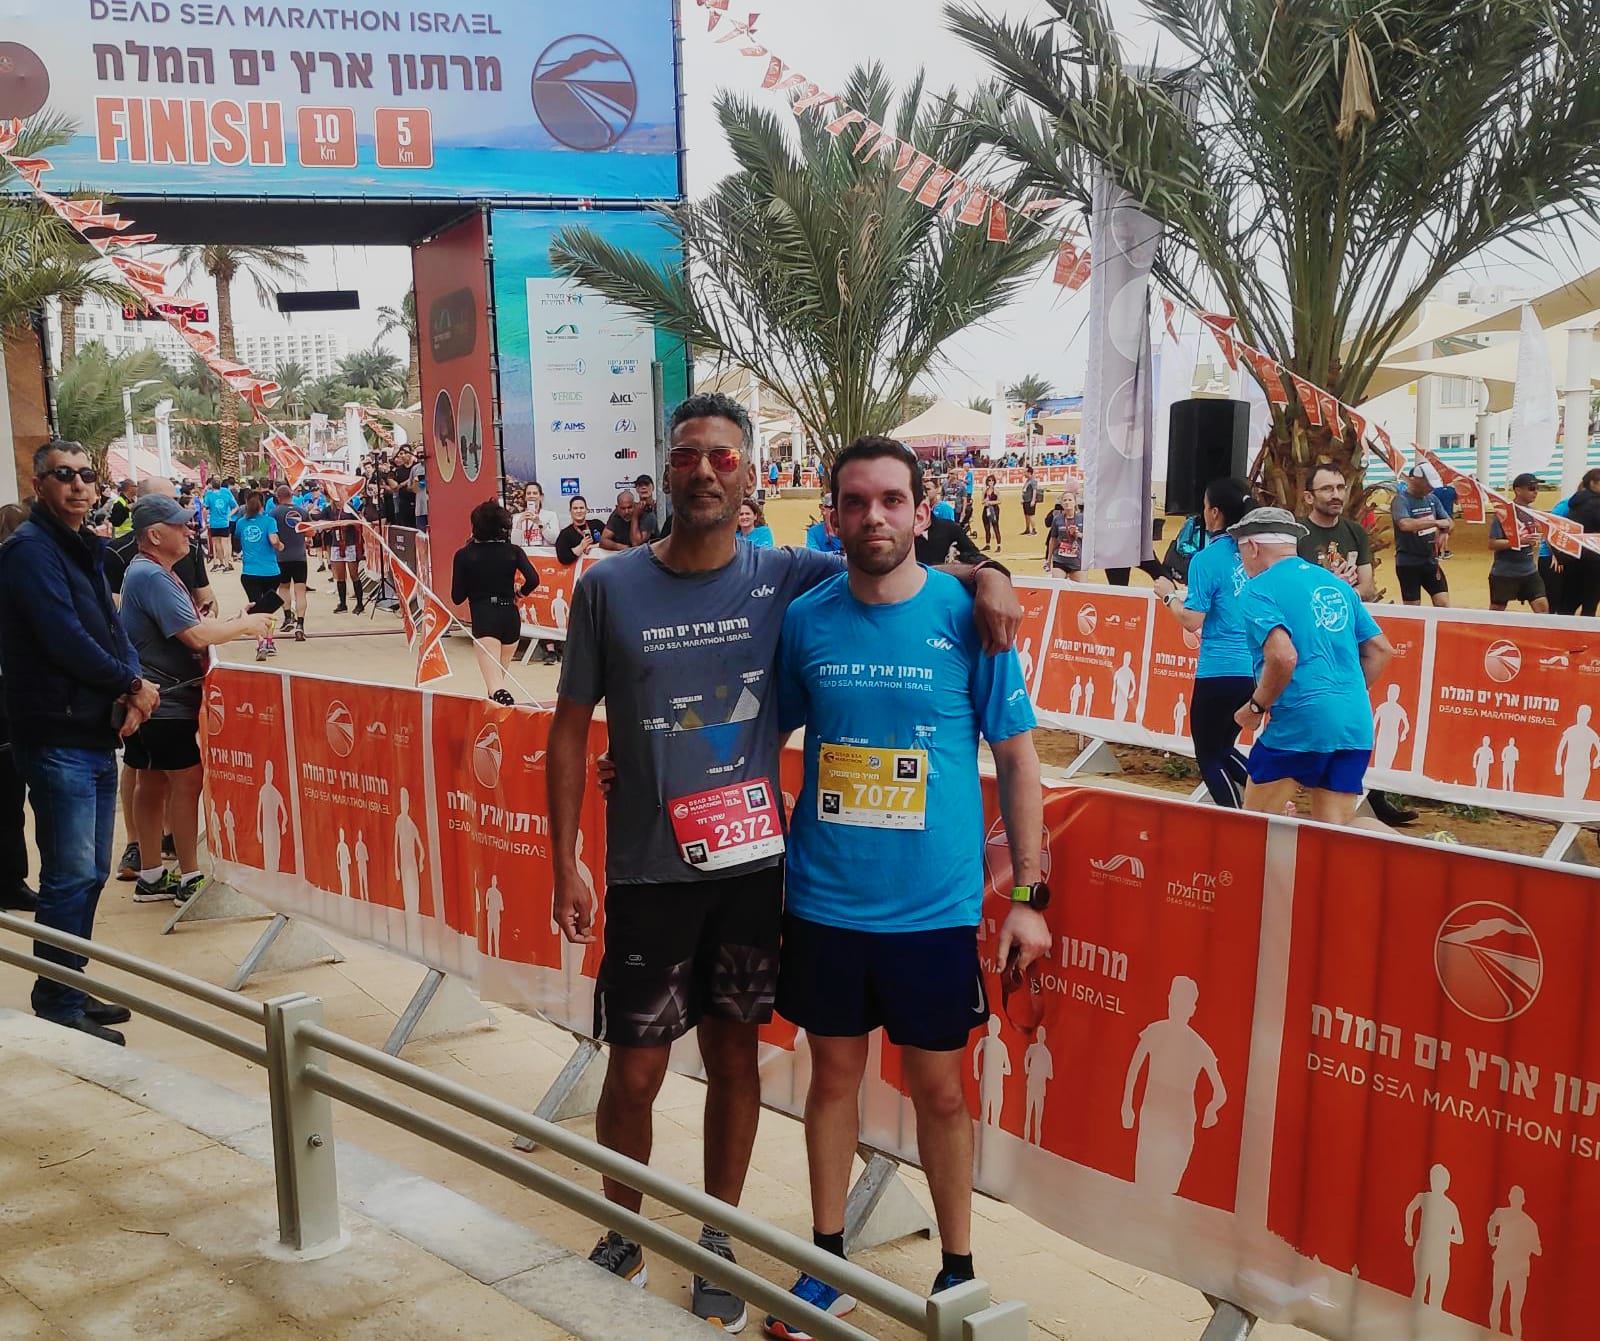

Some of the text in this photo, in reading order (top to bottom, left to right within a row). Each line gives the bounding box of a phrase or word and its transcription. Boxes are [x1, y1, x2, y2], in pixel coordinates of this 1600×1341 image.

[90, 0, 502, 34] DEAD SEA MARATHON ISRAEL
[93, 40, 502, 96] מרתון ארץ ים המלח
[95, 96, 287, 166] FINISH
[313, 113, 340, 143] 10
[397, 117, 411, 146] 5
[320, 145, 337, 161] Km
[398, 147, 414, 163] Km
[564, 422, 586, 431] AIMS
[552, 453, 586, 461] SUUNTO
[614, 448, 638, 459] allin
[642, 617, 749, 641] מרתון ארץ ים המלח
[643, 632, 752, 653] DEAD SEA MARATHON ISRAEL
[820, 664, 933, 680] מרתון ארץ ים המלח
[855, 680, 902, 689] MARATHON
[904, 682, 934, 692] ISRAEL
[1441, 686, 1560, 712] מרתון ארץ ים המלח
[1438, 705, 1559, 726] DEAD SEA MARATHON ISRAEL
[230, 749, 253, 768] מרתון
[302, 761, 389, 796] מרתון ארץ ים המלח
[688, 794, 721, 806] DEAD SEA
[852, 783, 916, 809] 7077
[448, 818, 471, 831] DEAD
[714, 814, 773, 848] 2372
[1167, 880, 1216, 903] ים המלח
[1192, 871, 1217, 888] ארץ
[1061, 936, 1128, 982] מרתון
[1072, 983, 1126, 1014] ISRAEL
[1311, 1003, 1402, 1059] המלח
[1414, 1033, 1452, 1071] ים
[1465, 1047, 1540, 1100] ארץ
[1307, 1053, 1366, 1085] DEAD
[1372, 1073, 1415, 1103] SEA
[1423, 1088, 1562, 1149] MARATHON
